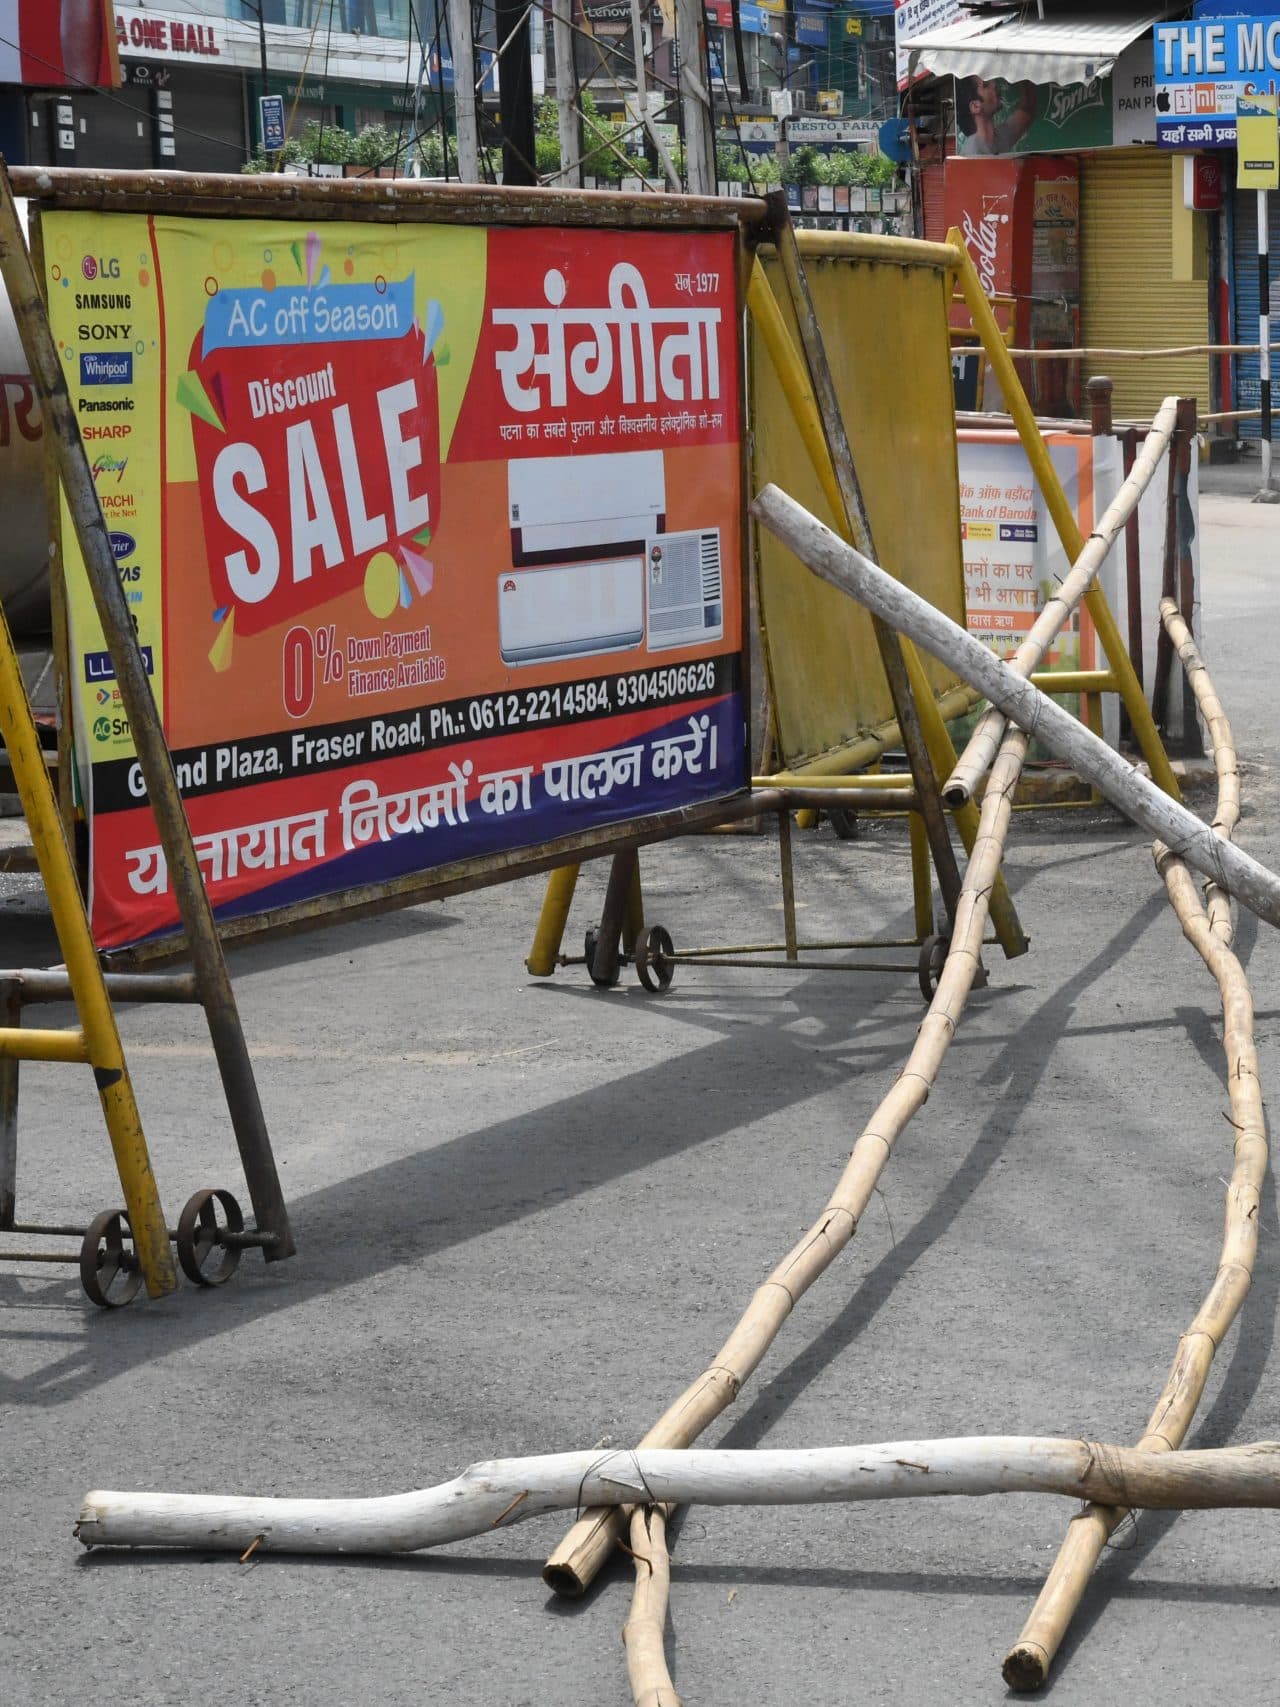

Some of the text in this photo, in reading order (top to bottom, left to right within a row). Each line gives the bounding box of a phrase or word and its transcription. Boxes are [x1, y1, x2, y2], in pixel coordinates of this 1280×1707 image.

[130, 17, 168, 51] ONE
[170, 21, 220, 56] MALL
[1158, 25, 1226, 75] THE
[1119, 97, 1140, 111] PAN
[842, 121, 885, 132] PARA
[1160, 124, 1185, 143] यहाँ
[1187, 123, 1213, 142] सभी
[1216, 126, 1238, 143] प्रक
[75, 293, 132, 310] SAMSUNG
[227, 294, 399, 337] AC off Season
[78, 324, 133, 341] SONY
[492, 262, 722, 413] संगीता
[85, 360, 129, 379] Whirlpool
[247, 361, 337, 419] Discount
[78, 396, 135, 412] Panasonic
[82, 425, 132, 441] SHARP
[499, 423, 523, 442] पटना
[526, 423, 540, 440] का
[543, 416, 567, 439] सबसे
[570, 419, 596, 444] पुराना
[599, 414, 616, 436] और
[100, 494, 134, 509] TACHI
[212, 378, 430, 604] SALE
[960, 504, 1038, 521] Bank of Baroda
[964, 556, 1034, 580] पनों का घर
[975, 581, 992, 602] भी
[967, 614, 992, 627] ावास
[347, 625, 432, 664] Down Payment
[88, 654, 149, 677] LLD
[282, 624, 344, 719] 0%
[347, 655, 447, 697] Finance Available
[127, 750, 207, 798] Gnd
[216, 743, 284, 783] Plaza,
[291, 730, 365, 768] Fraser
[371, 713, 426, 751] Road,
[468, 679, 613, 733] 0612-2214584,
[616, 661, 716, 708] 9304506626
[125, 807, 329, 896] यतायात
[478, 765, 534, 816] का
[541, 743, 645, 802] पालन
